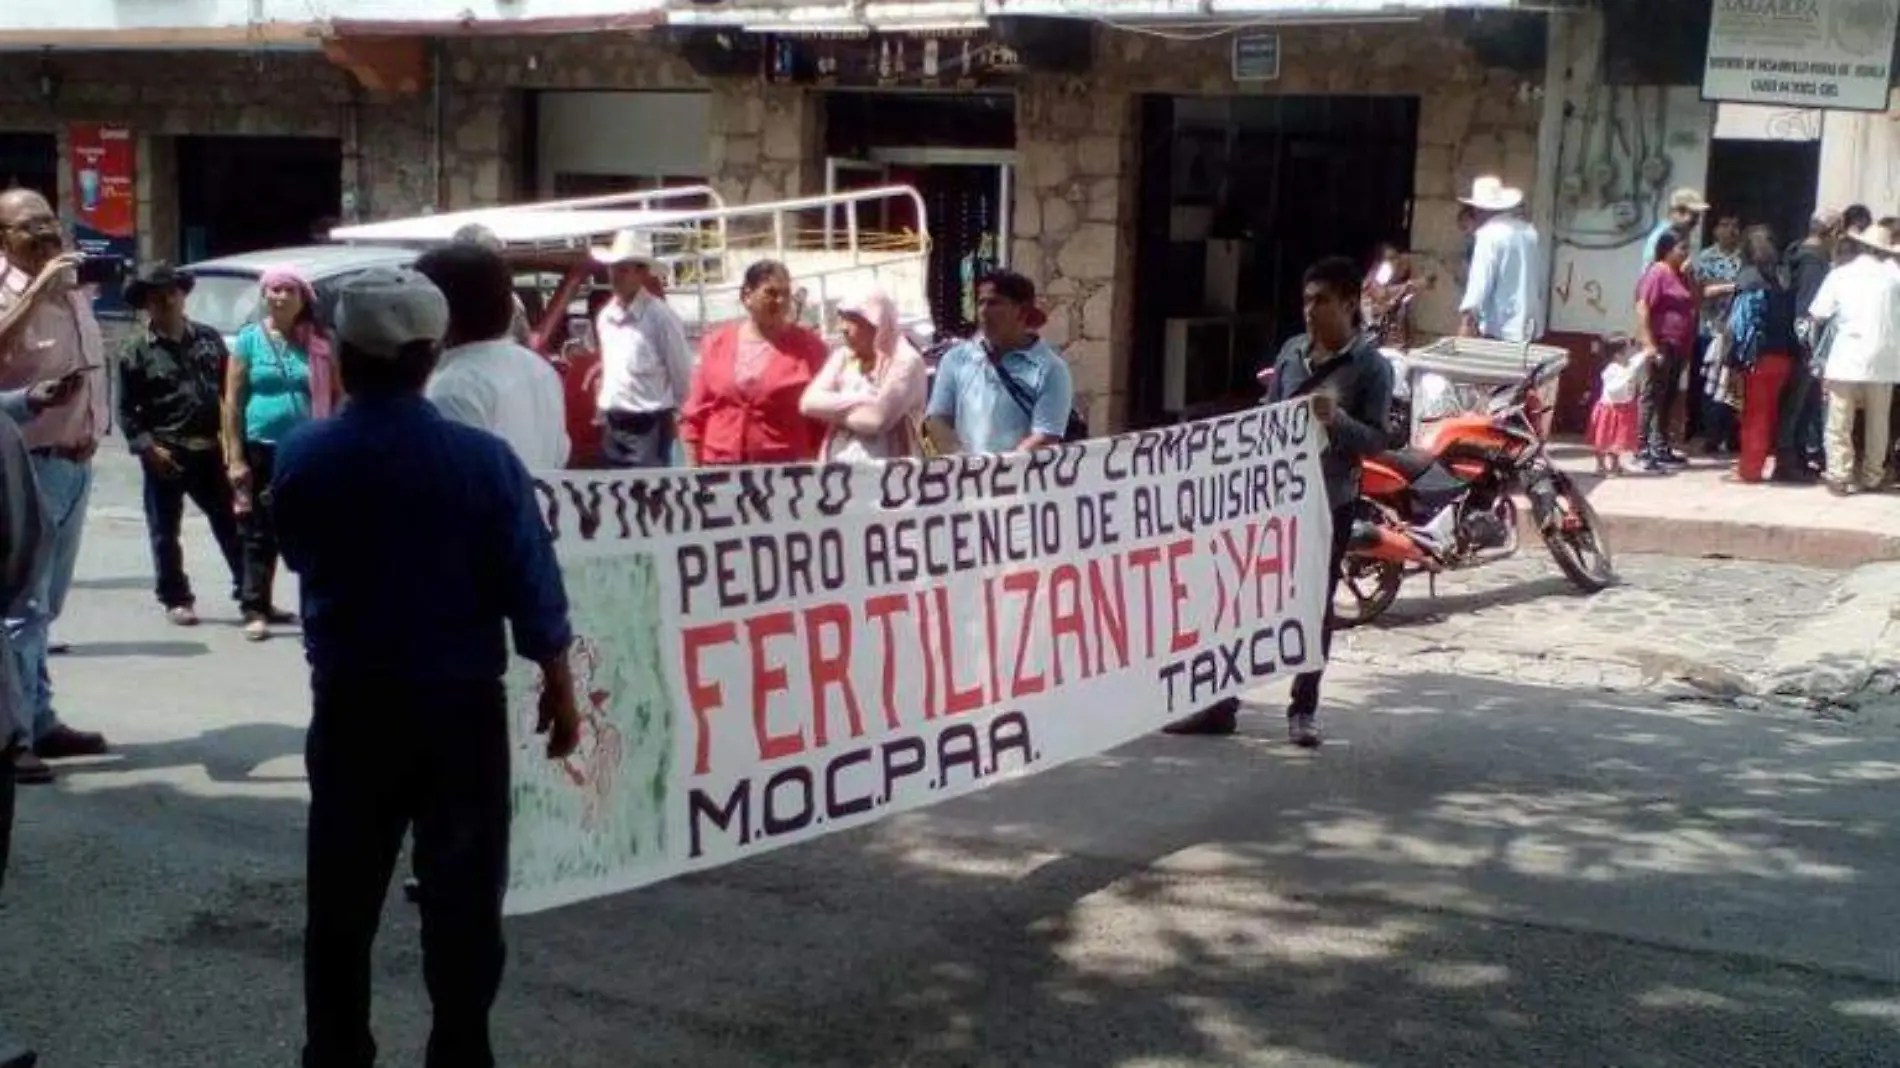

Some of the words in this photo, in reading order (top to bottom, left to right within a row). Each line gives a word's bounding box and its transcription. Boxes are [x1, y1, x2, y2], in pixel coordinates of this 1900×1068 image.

[533, 466, 852, 541] OVIMIENTO
[880, 445, 1087, 509] OBRERO
[1103, 401, 1309, 480] CAMPESINO
[677, 528, 845, 615] PEDRO
[864, 502, 1060, 587] ASCENCIO
[1077, 491, 1119, 549] DE
[680, 539, 1199, 775] FERTILIZANTE
[1210, 516, 1297, 634] ¡YA!
[1159, 619, 1306, 712] TAXCO
[687, 711, 1040, 858] M.O.C.P.A.A.
